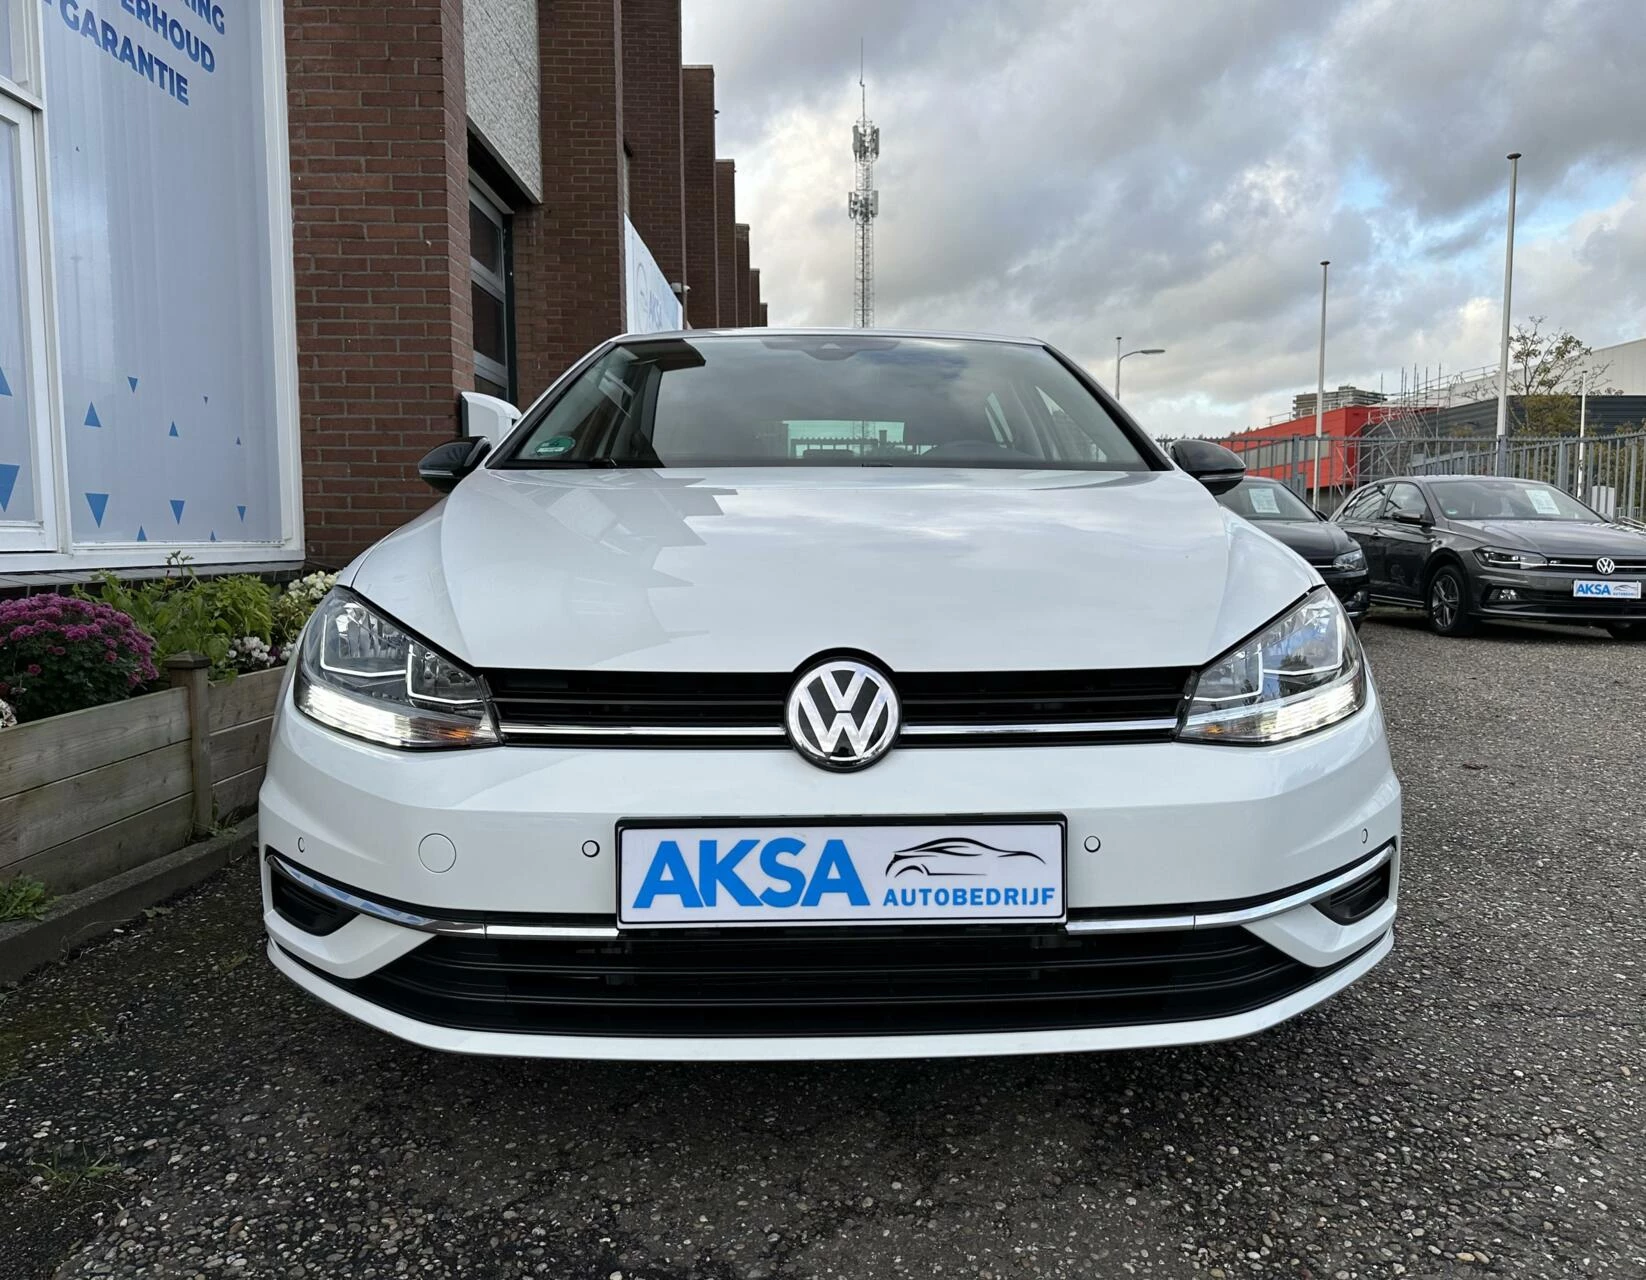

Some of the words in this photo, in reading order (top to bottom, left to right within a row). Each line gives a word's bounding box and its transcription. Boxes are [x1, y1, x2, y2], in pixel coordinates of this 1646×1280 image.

[60, 0, 189, 106] GARANTIE
[1576, 583, 1611, 596] AKSA
[632, 837, 871, 909] AKSA
[882, 887, 1055, 907] AUTOBEDRIJF
